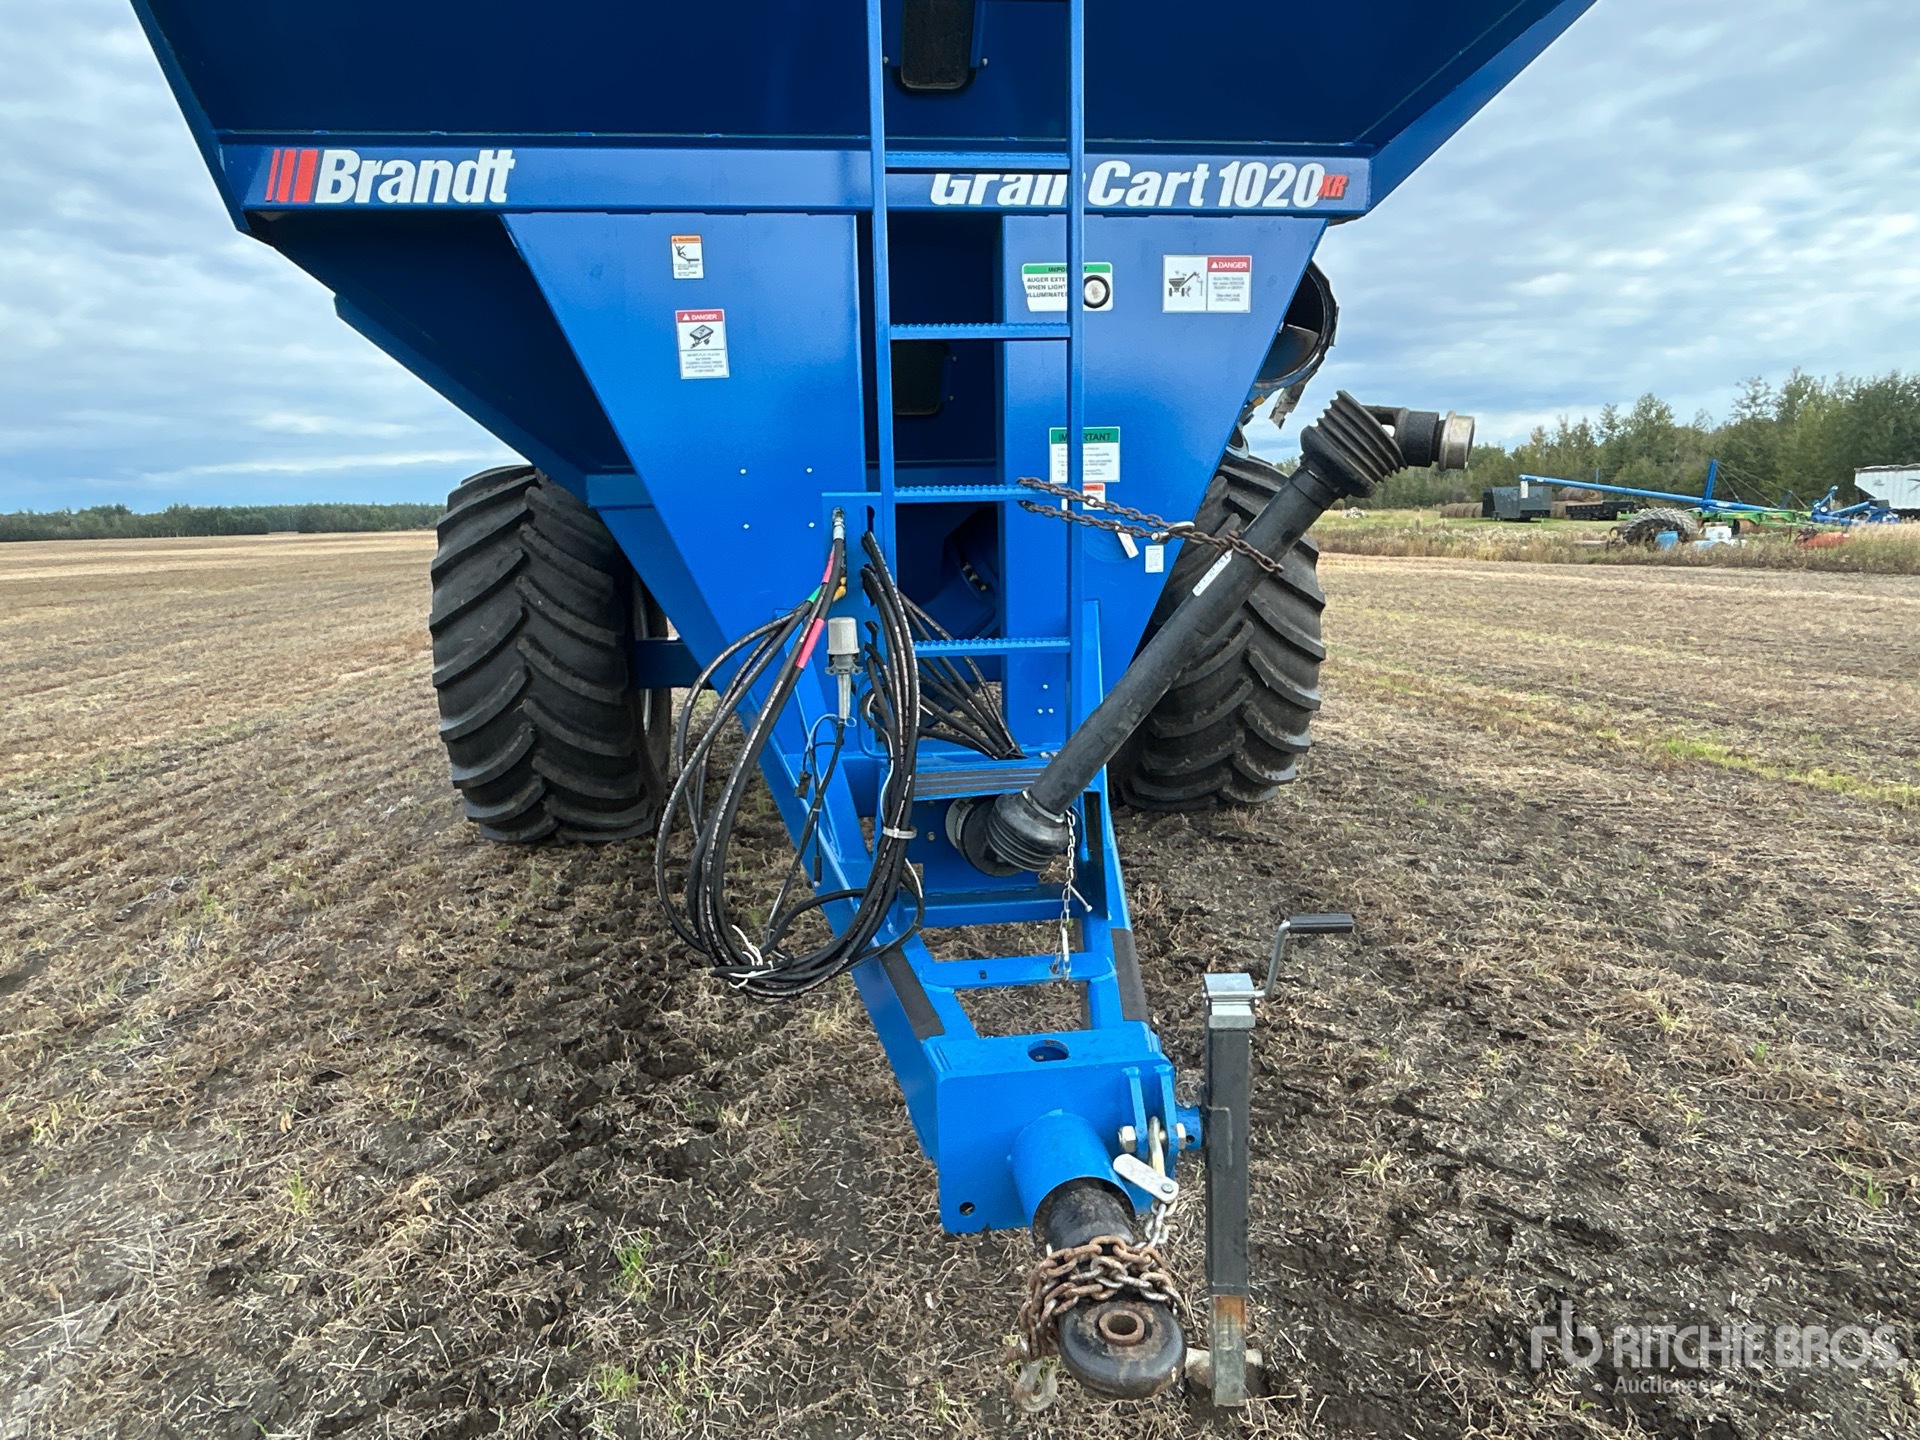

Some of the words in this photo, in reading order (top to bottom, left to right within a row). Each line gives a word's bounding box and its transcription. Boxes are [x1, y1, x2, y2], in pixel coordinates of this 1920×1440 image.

[314, 149, 516, 203] Brandt
[1088, 160, 1210, 207] Cart
[1218, 160, 1326, 207] 1020
[1317, 174, 1349, 199] XR
[1218, 261, 1248, 269] DANGER
[691, 313, 718, 321] DANGER
[1058, 432, 1112, 442] IMRTANT
